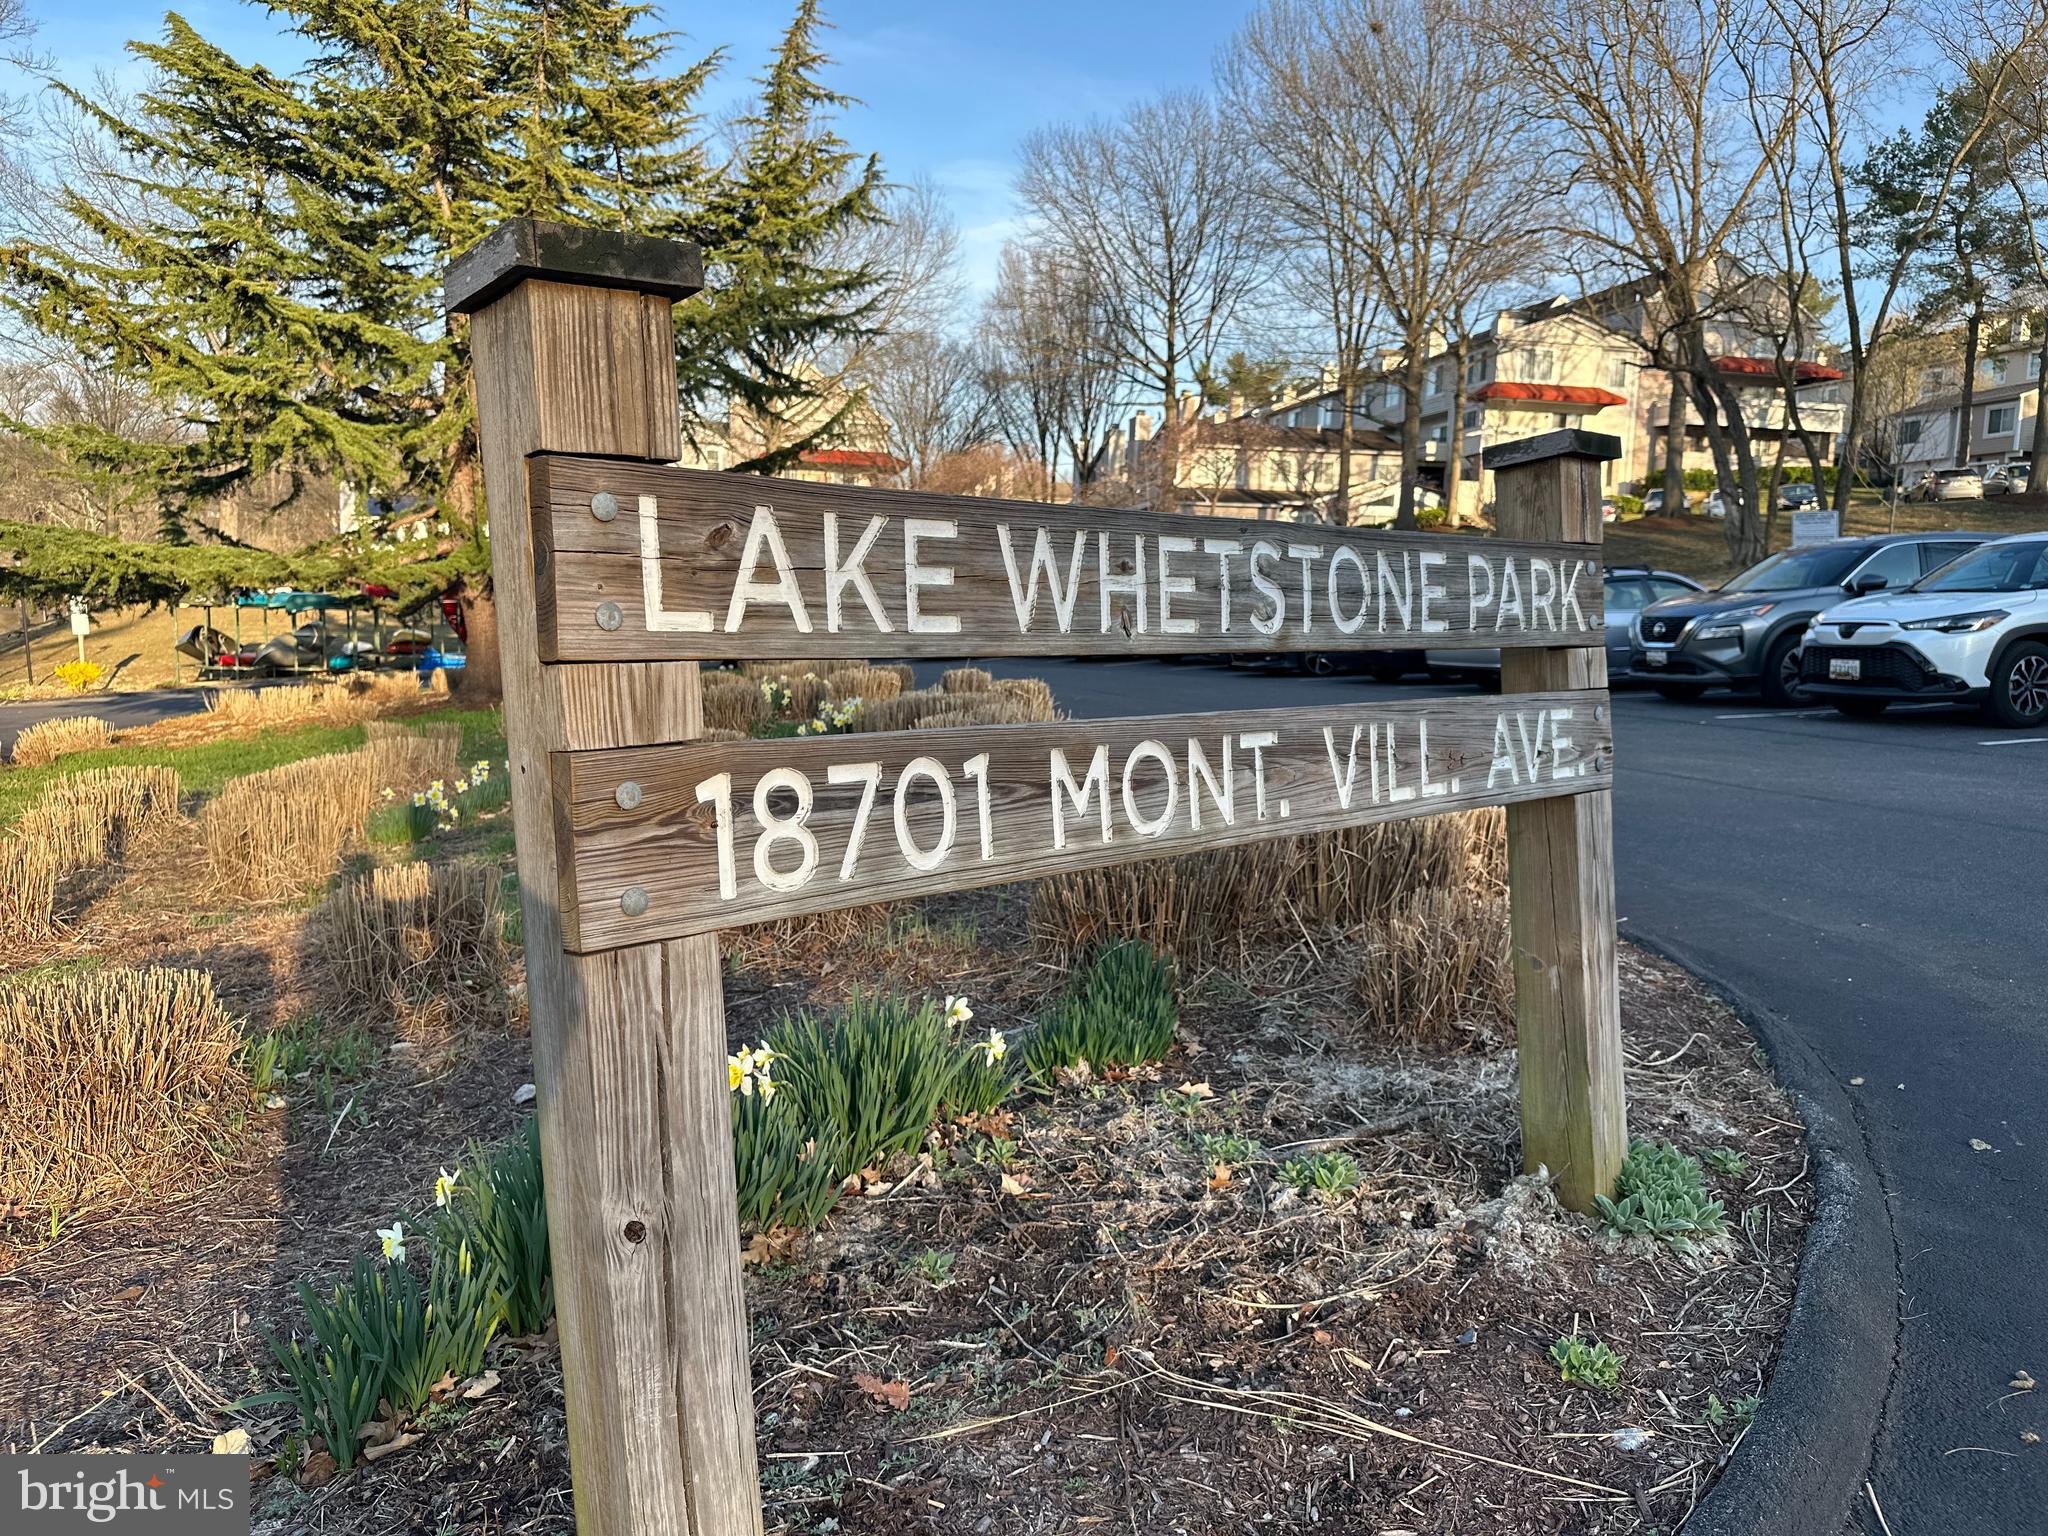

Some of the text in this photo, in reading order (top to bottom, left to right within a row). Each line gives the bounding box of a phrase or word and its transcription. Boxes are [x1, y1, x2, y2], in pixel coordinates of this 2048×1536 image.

[638, 494, 1588, 635] LAKE WHETSTONE PARK
[695, 707, 1586, 901] 18701 MONT. VILL. AVE.
